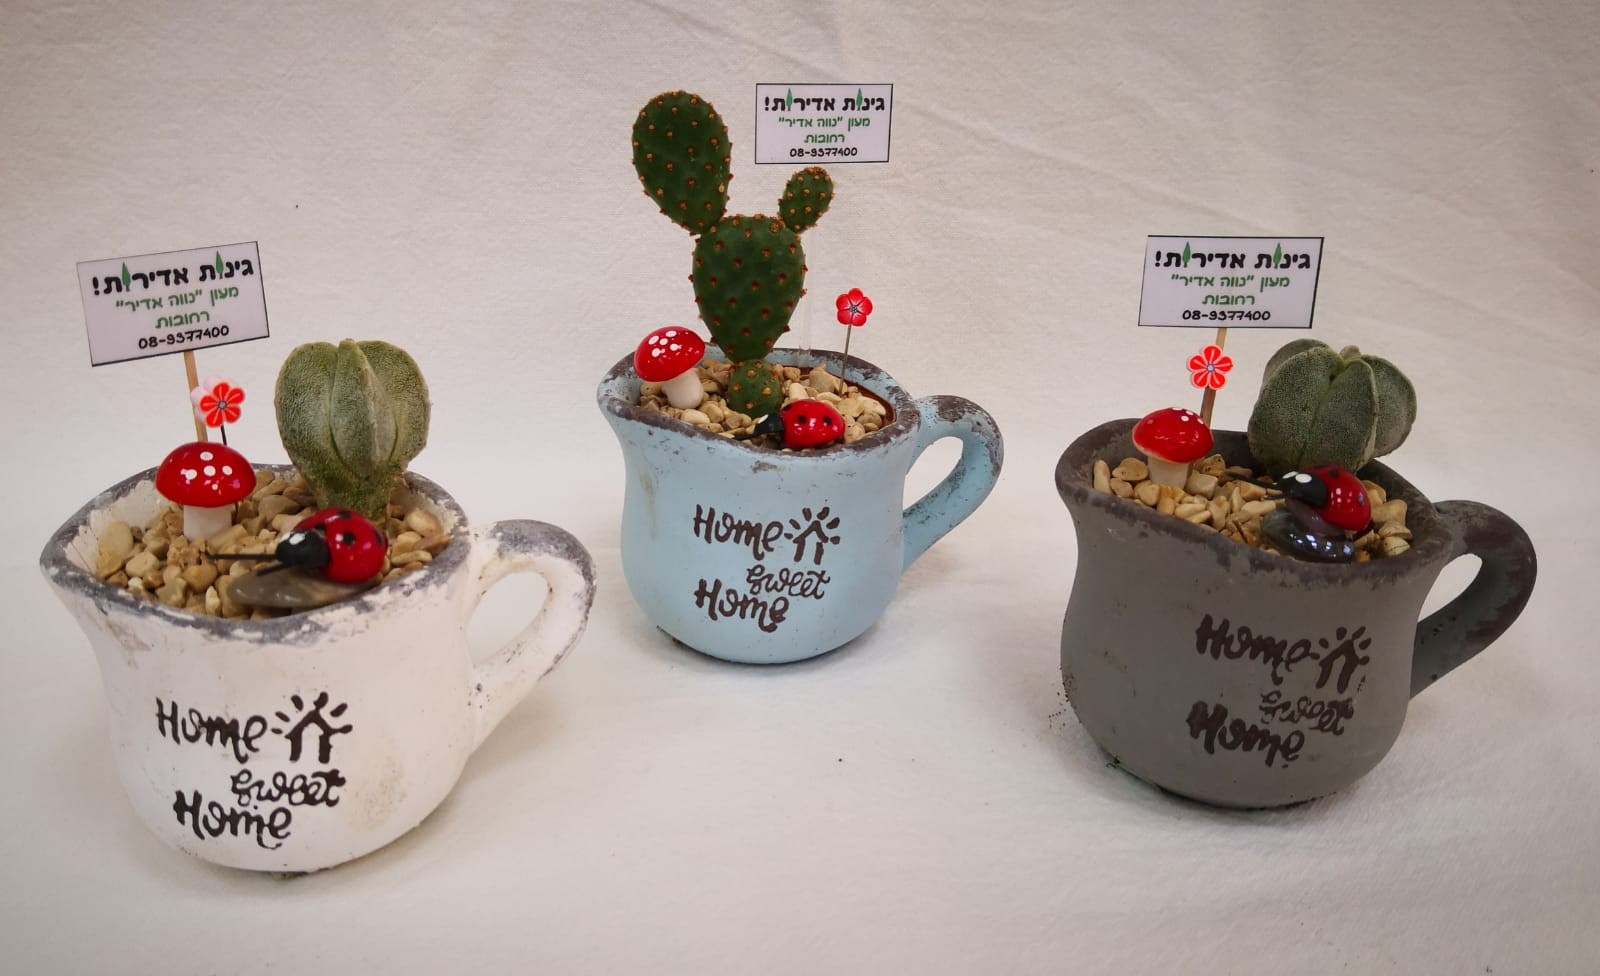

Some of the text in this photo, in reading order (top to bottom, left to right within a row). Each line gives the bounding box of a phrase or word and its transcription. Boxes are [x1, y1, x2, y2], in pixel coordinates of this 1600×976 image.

[848, 117, 871, 132] מעון
[804, 134, 845, 144] רחובות
[789, 147, 858, 158] 08-9377400
[1260, 275, 1290, 293] מעון
[210, 286, 239, 306] מעון
[1201, 294, 1255, 306] רחובות
[155, 310, 210, 329] רחובות
[1182, 310, 1271, 321] 08-9377400
[138, 325, 230, 350] 08-9377400
[693, 503, 784, 561] Home
[693, 578, 790, 633] Home
[1195, 613, 1312, 686] Home
[155, 696, 268, 765] Home
[1185, 700, 1305, 768] Home
[173, 789, 292, 850] Home
